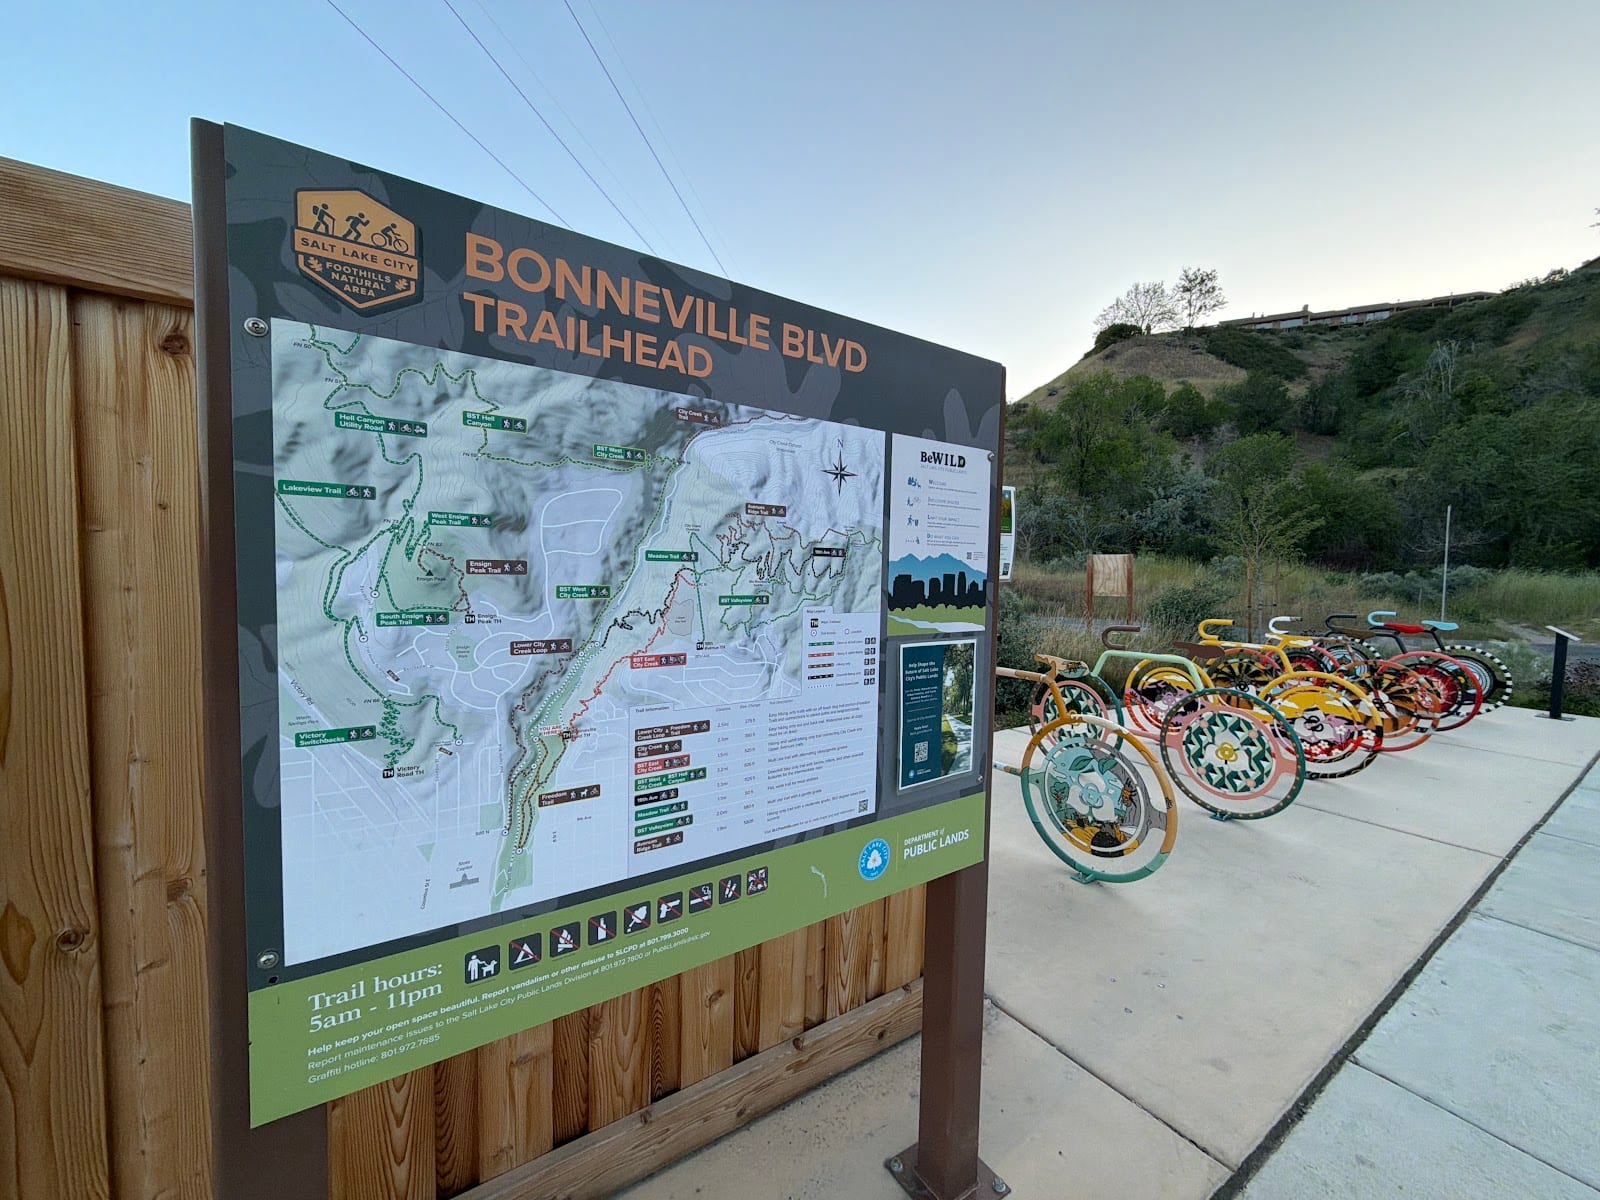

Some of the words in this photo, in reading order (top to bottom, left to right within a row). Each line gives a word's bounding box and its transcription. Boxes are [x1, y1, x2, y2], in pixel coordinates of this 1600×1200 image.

[301, 237, 336, 253] SALT
[342, 247, 378, 264] LAKE
[383, 258, 414, 273] CITY
[326, 261, 391, 284] FOOTHILLS
[331, 272, 386, 291] NATURAL
[344, 283, 375, 298] AREA
[465, 231, 770, 351] BONNEVILLE
[781, 323, 867, 374] BLVD
[463, 292, 714, 379] TRAILHEAD
[339, 413, 355, 421] Hell
[356, 415, 385, 425] Canyon
[339, 421, 363, 430] Utility
[466, 419, 492, 428] Canyon
[482, 414, 495, 422] Hell
[837, 438, 844, 448] N
[920, 451, 966, 468] BeWILD
[283, 484, 322, 493] Lakeview
[470, 561, 492, 569] Ensign
[533, 641, 546, 649] City
[290, 679, 307, 698] Victory
[306, 696, 315, 706] Rd
[299, 732, 326, 741] Victory
[299, 737, 345, 746] Switchbacks
[396, 765, 420, 773] Victory
[541, 792, 567, 800] Freedom
[637, 809, 659, 818] Meadow
[903, 843, 937, 860] PUBLIC
[939, 829, 969, 848] LANDS
[904, 830, 939, 846] DEPARTMENT
[940, 828, 945, 836] of
[308, 981, 365, 1012] Trail
[373, 963, 443, 993] hours:
[308, 1042, 333, 1056] Help
[335, 1036, 360, 1049] keep
[361, 1029, 384, 1041] your
[386, 1020, 410, 1034] open
[412, 1010, 438, 1026] space
[440, 997, 480, 1014] beautiful.
[482, 986, 510, 1001] Report
[511, 974, 550, 991] vandalism
[551, 970, 559, 978] or
[561, 964, 580, 975] other
[581, 955, 606, 968] misuse
[615, 944, 639, 957] SLCPD
[647, 927, 689, 947] 801.799.3000
[308, 1054, 342, 1070] Report
[344, 1034, 403, 1058] maintenance
[406, 1025, 433, 1037] issues
[446, 1015, 460, 1026] the
[462, 1009, 477, 1021] Salt
[479, 1003, 498, 1015] Lake
[500, 996, 515, 1006] City
[517, 987, 540, 1001] Public
[541, 981, 563, 993] Lands
[565, 971, 592, 985] Division
[601, 952, 644, 973] 801.972.7800
[309, 1008, 361, 1033] 5am
[388, 983, 443, 1011] 11pm
[308, 1068, 342, 1084] Graffiti
[344, 1056, 379, 1072] hotline:
[380, 1033, 441, 1060] 801.972.7885
